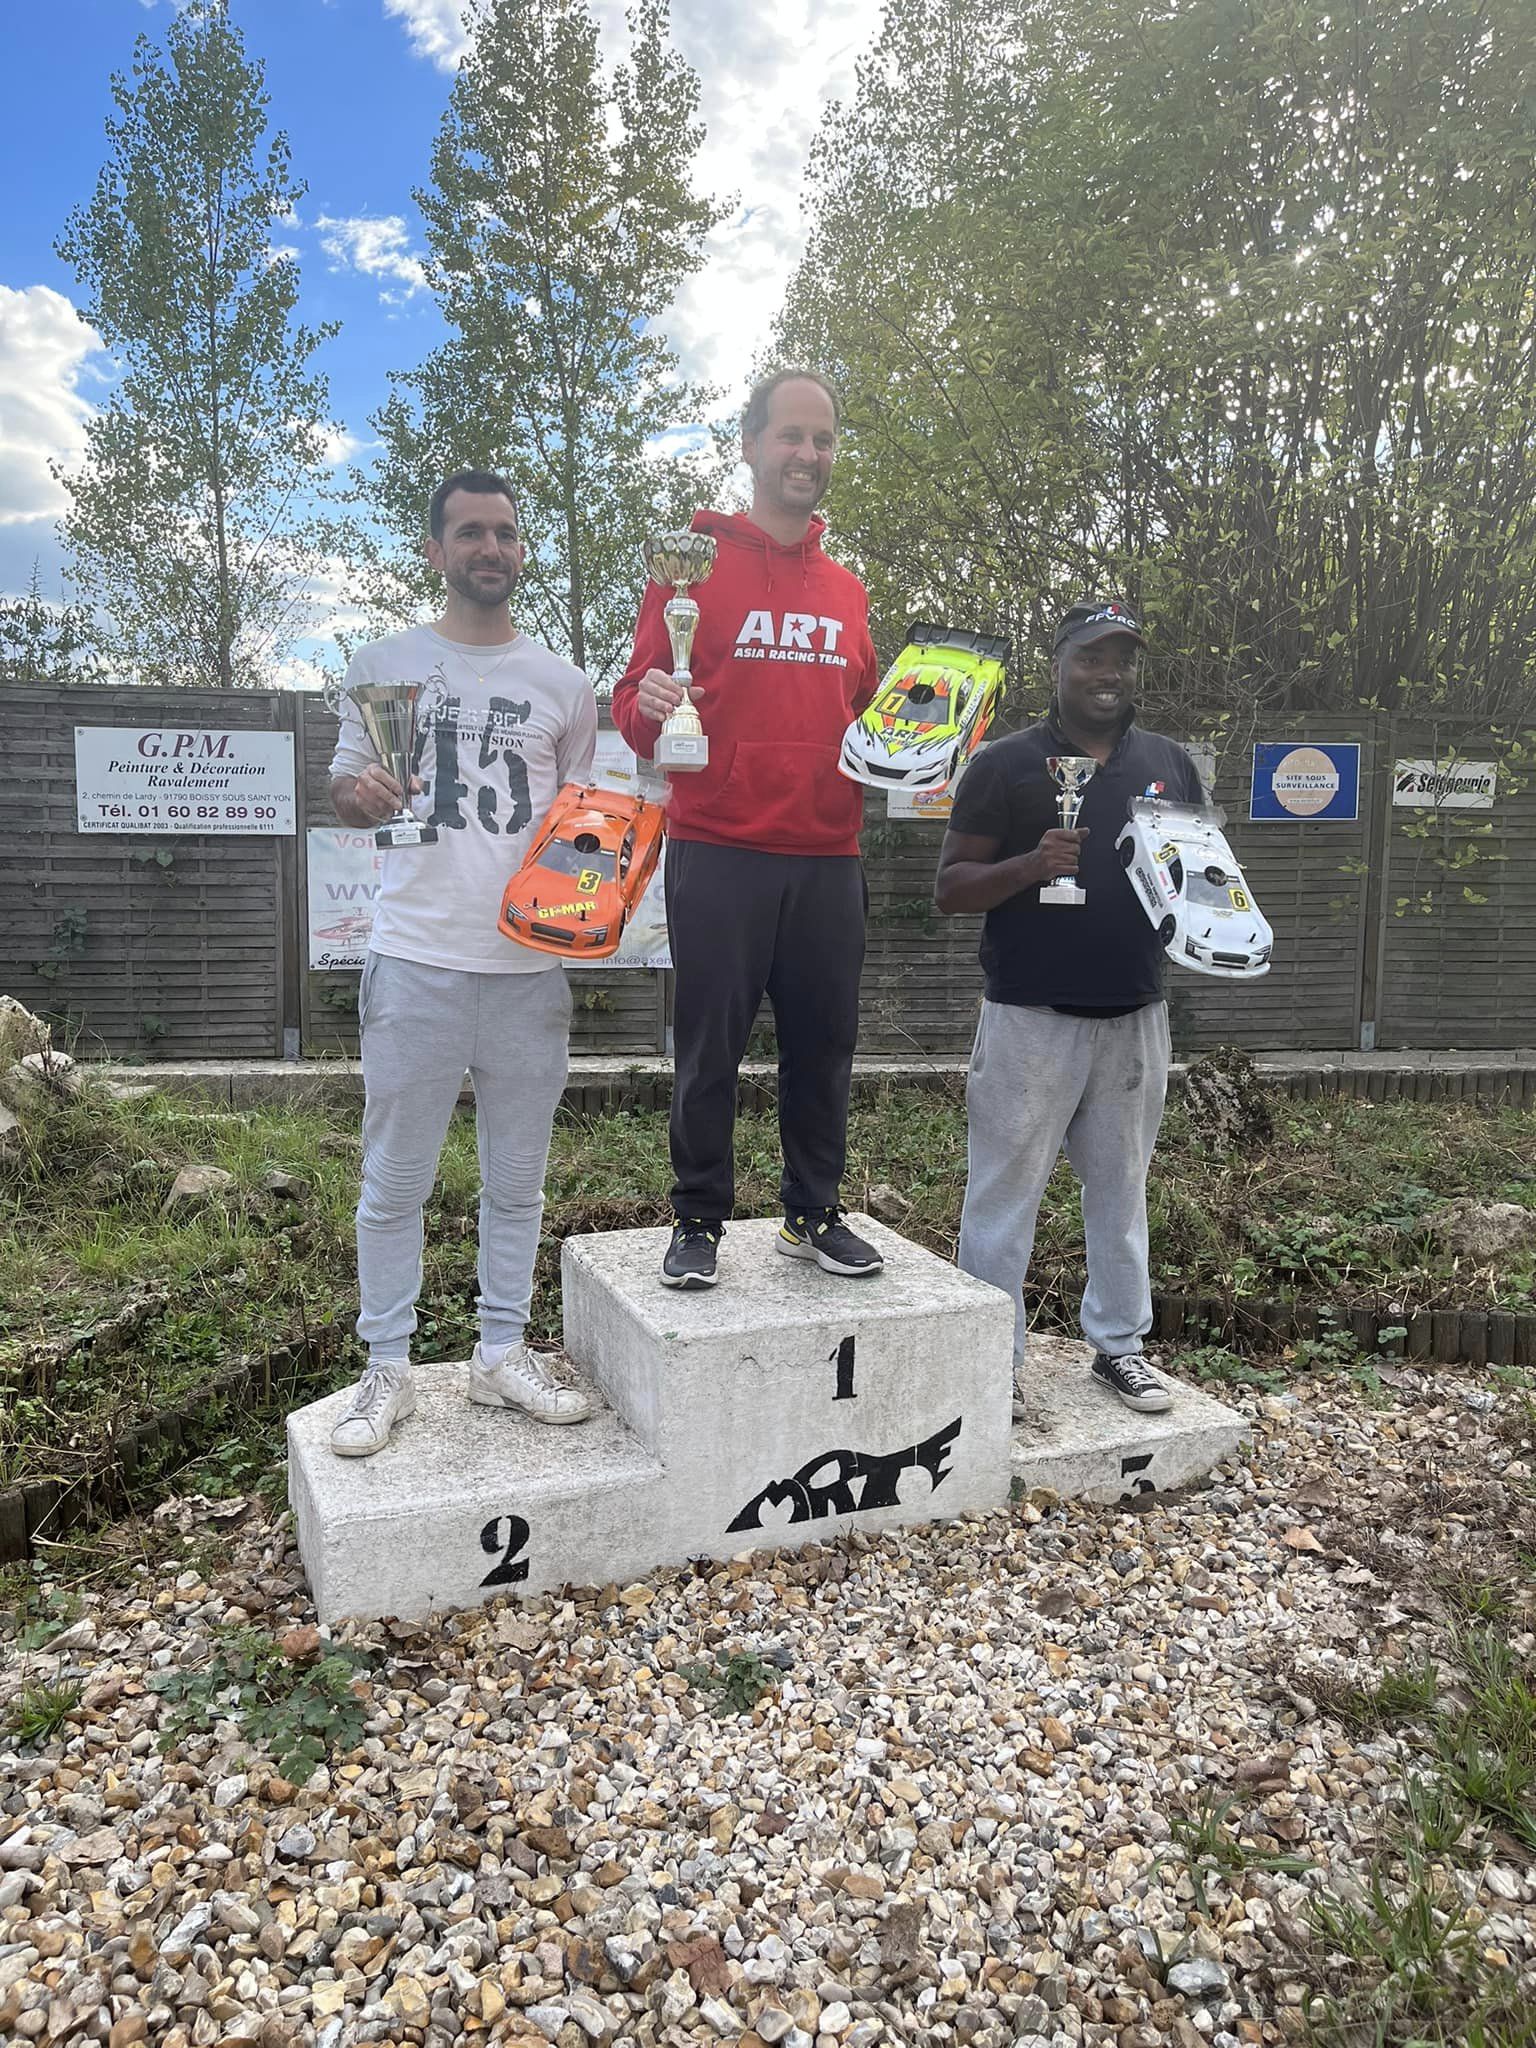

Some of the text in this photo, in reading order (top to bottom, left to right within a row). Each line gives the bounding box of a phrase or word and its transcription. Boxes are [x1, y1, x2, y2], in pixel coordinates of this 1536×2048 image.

[735, 610, 844, 652] ART
[733, 647, 849, 668] ASIA RACING TEAM
[886, 695, 903, 710] 1
[461, 732, 524, 749] DIVISION
[880, 727, 923, 740] ART
[138, 732, 234, 759] G.P.M.
[108, 760, 265, 775] Peinture & Décoration
[147, 775, 230, 788] Ravalement
[92, 792, 121, 800] chemin
[123, 792, 133, 800] de
[135, 793, 156, 801] Lardy
[189, 793, 220, 801] BOISSY
[273, 794, 291, 802] YON
[98, 803, 276, 819] Tél. 01 60 82 89 90
[83, 821, 119, 829] CERTIFICAT
[173, 822, 212, 830] Qualification
[212, 823, 258, 831] professionnelle
[579, 872, 599, 890] 3
[1233, 890, 1246, 908] 6
[828, 1335, 858, 1401] 1
[478, 1514, 531, 1588] 2
